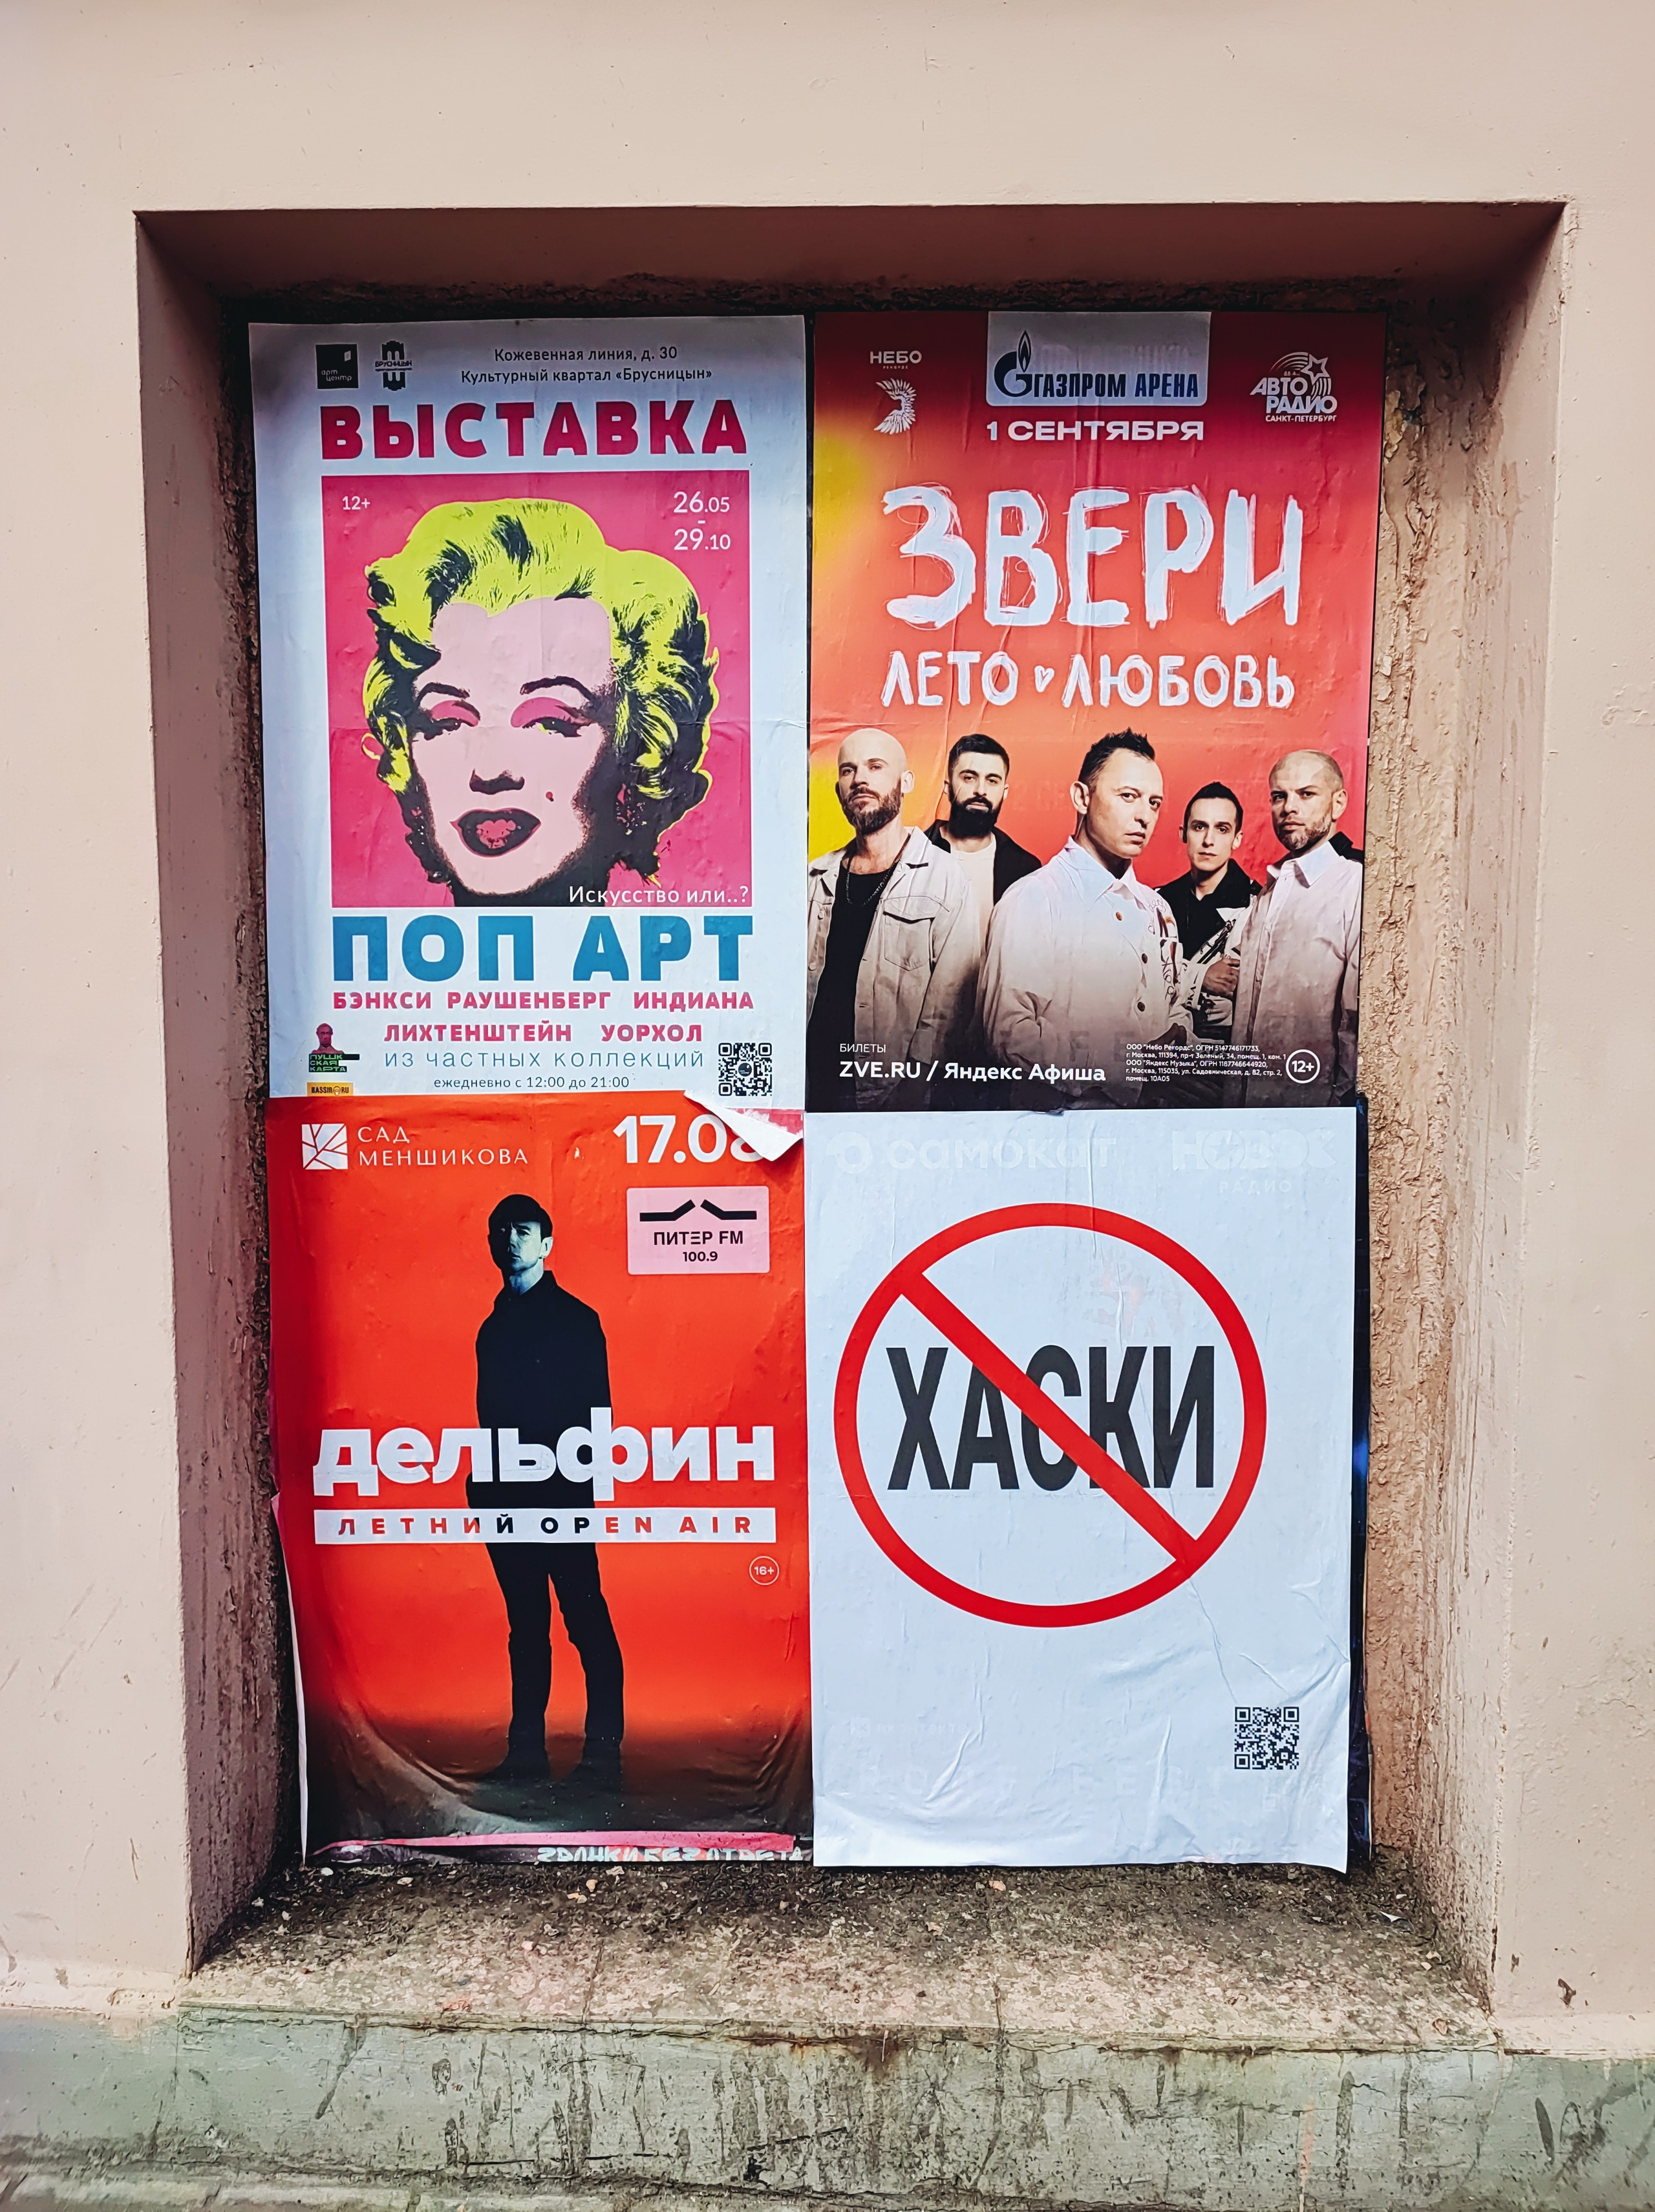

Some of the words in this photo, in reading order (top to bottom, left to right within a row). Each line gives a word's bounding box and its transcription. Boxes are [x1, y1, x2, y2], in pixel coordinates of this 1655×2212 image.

[495, 349, 582, 361] Кожевенная
[588, 348, 637, 362] линия,
[641, 349, 655, 362] д.
[659, 346, 678, 359] 30
[870, 350, 922, 364] НЕБО
[461, 369, 548, 384] Культурный
[553, 370, 611, 383] квартал
[615, 368, 712, 383] «Брусницын»
[1034, 373, 1126, 398] ГАЗПРОМ
[1135, 373, 1199, 398] АРЕНА
[1250, 377, 1308, 396] АВТО
[1266, 395, 1338, 414] РАДИО
[319, 399, 747, 460] ВЫСТАВКА
[987, 421, 998, 441] 1
[1007, 421, 1204, 441] СЕНТЯБРЯ
[342, 496, 371, 511] 12+
[673, 491, 730, 514] 26.05
[674, 527, 731, 551] 29.10
[882, 483, 1304, 630] ЗВЕРИ
[881, 650, 1020, 707] ЛЕТО
[1062, 654, 1295, 708] ЛЮБОВЬ
[569, 886, 679, 906] Искусство
[687, 886, 749, 904] или..?
[332, 915, 535, 983] ПОП
[572, 915, 754, 982] АРТ
[333, 992, 431, 1009] БЭНКСИ
[447, 992, 611, 1009] РАУШЕНБЕРГ
[633, 992, 754, 1012] ИНДИАНА
[383, 1020, 571, 1042] ЛИХТЕНШТЕЙН
[601, 1024, 703, 1042] УОРХОЛ
[840, 1043, 886, 1053] БИЛЕТЫ
[385, 1052, 414, 1067] из
[426, 1052, 541, 1067] частных
[554, 1050, 703, 1070] коллекций
[1291, 1060, 1315, 1073] 12+
[839, 1061, 921, 1079] ZVE.RU
[926, 1060, 939, 1081] /
[943, 1062, 1022, 1082] Яндекс
[1028, 1063, 1106, 1085] Афиша
[434, 1078, 511, 1091] ежедневно
[515, 1079, 522, 1088] с
[526, 1076, 565, 1088] 12:00
[568, 1078, 586, 1090] до
[590, 1076, 630, 1088] 21:00
[357, 1126, 410, 1143] САД
[359, 1148, 528, 1167] МЕНШИКОВА
[654, 1231, 713, 1246] ПИТЕР
[719, 1230, 743, 1244] FM
[682, 1251, 718, 1262] 100.9
[886, 1344, 1215, 1491] ХАСКИ
[313, 1407, 775, 1502] дельфин
[338, 1514, 514, 1536] ЛЕТНИЙ
[540, 1516, 652, 1535] OPEN
[679, 1516, 751, 1535] AIR
[753, 1566, 775, 1576] 16+
